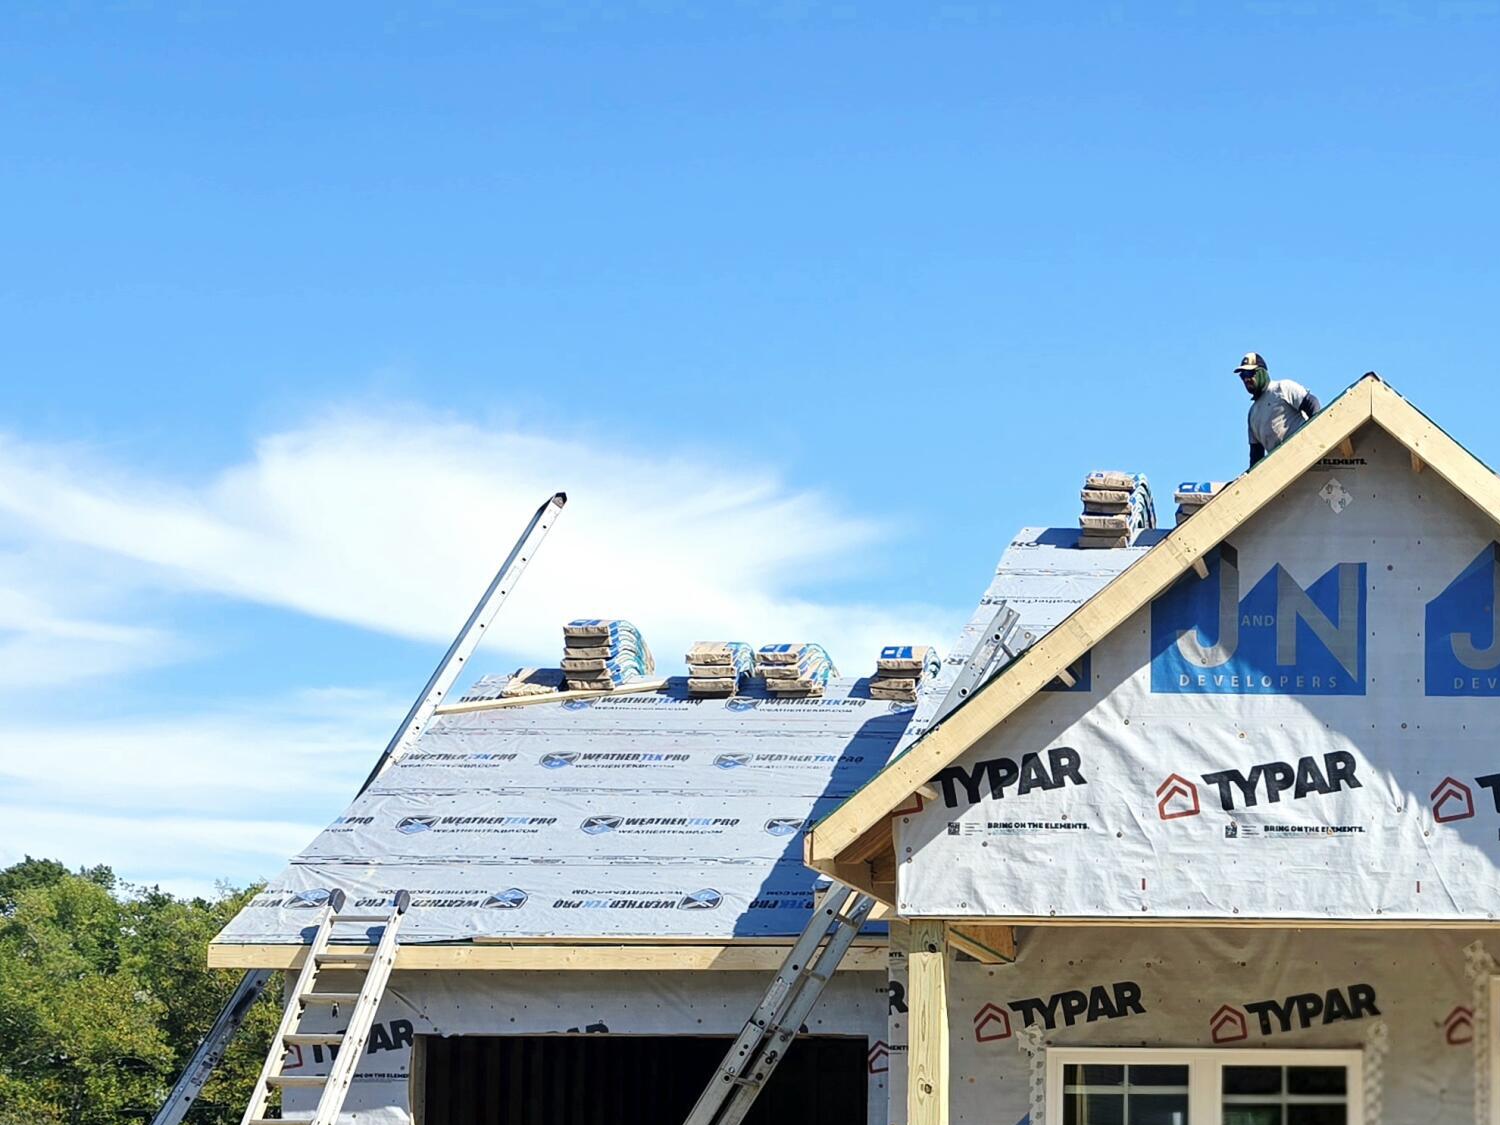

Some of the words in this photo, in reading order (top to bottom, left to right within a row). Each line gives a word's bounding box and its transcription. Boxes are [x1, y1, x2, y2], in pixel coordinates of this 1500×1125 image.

[1241, 614, 1275, 627] AND
[1178, 674, 1338, 688] DEVELOPERS
[842, 699, 866, 707] PRO
[664, 753, 690, 761] PRO
[838, 755, 864, 763] PRO
[929, 747, 1088, 808] TYPAR
[1200, 751, 1363, 811] TYPAR
[529, 817, 557, 825] PRO
[625, 817, 712, 826] WEATHERTEK
[712, 818, 740, 826] PRO
[355, 899, 385, 907] PRO
[553, 900, 583, 908] PRO
[583, 900, 676, 908] WEATHERTEK
[1007, 981, 1147, 1030] TYPAR
[1243, 983, 1381, 1035] TYPAR
